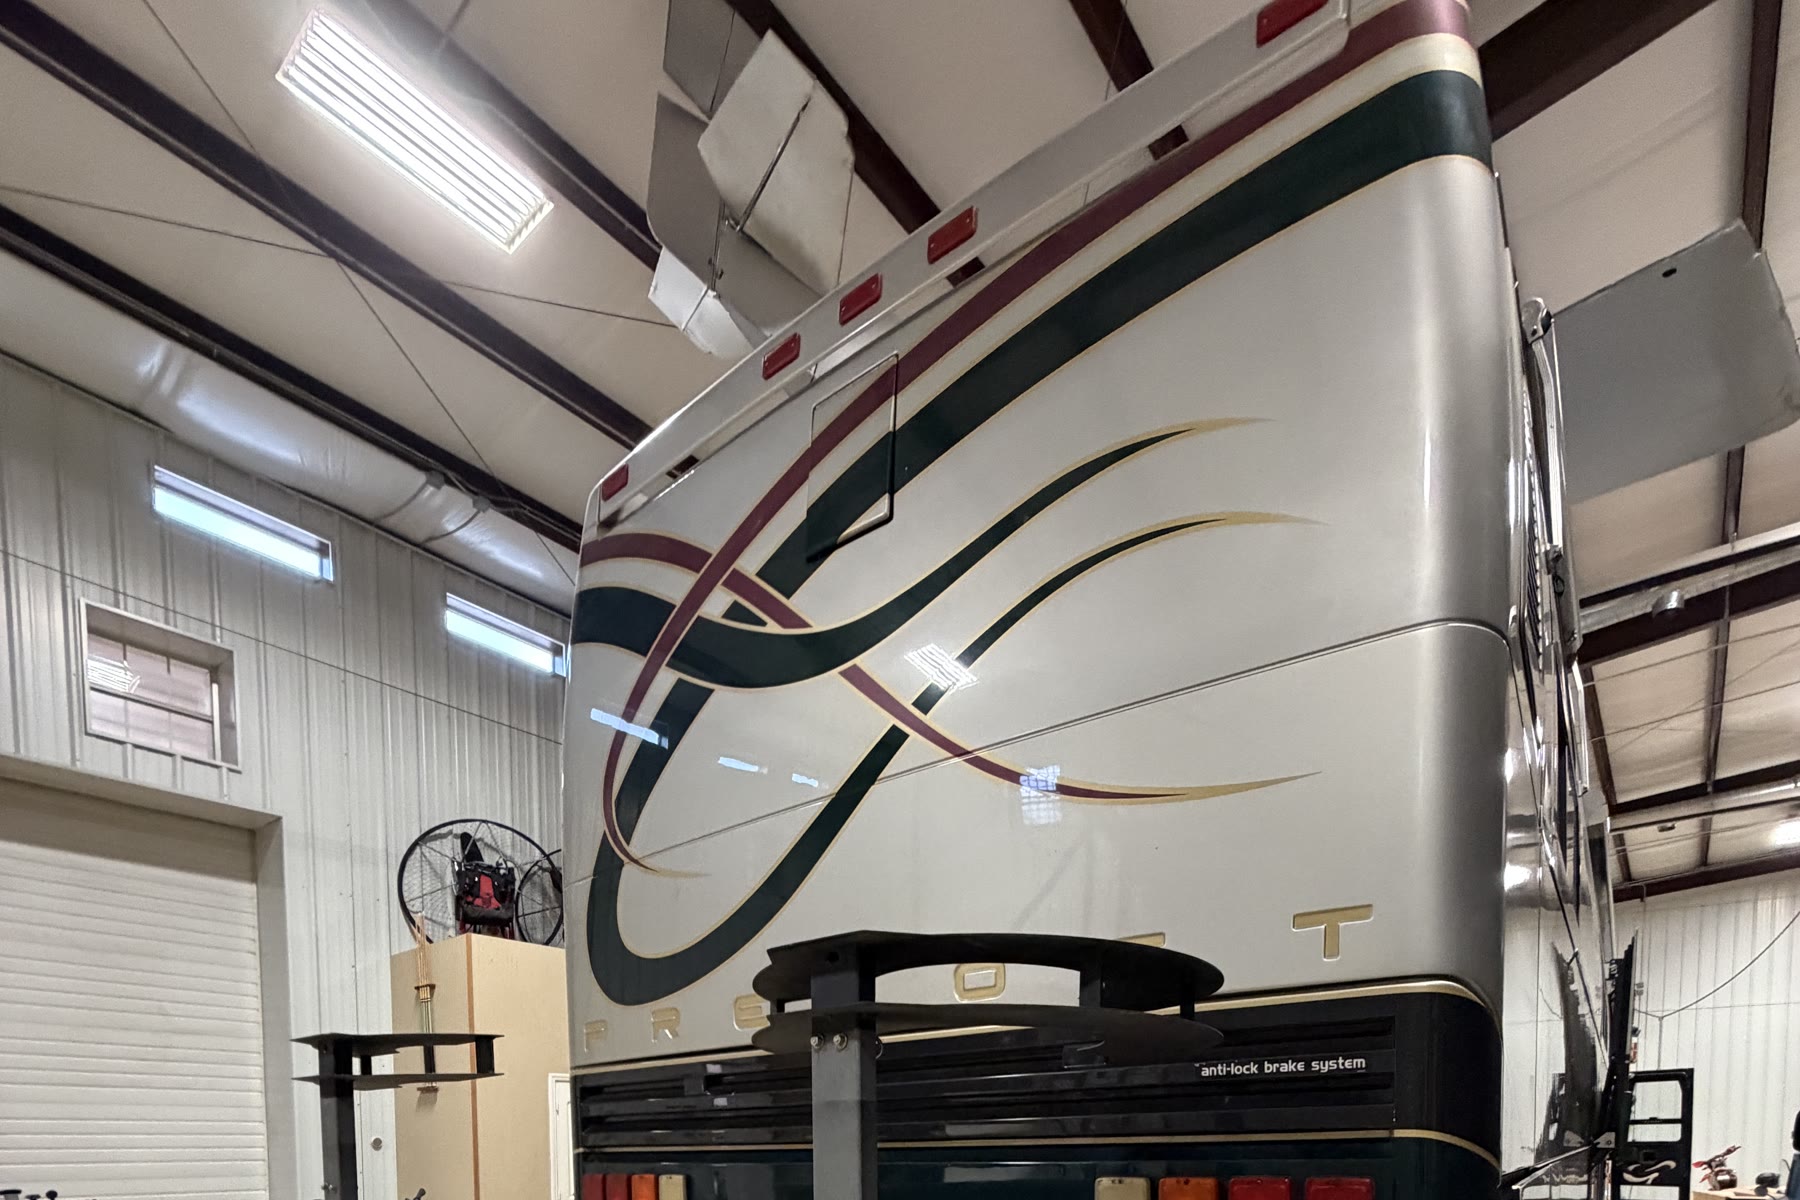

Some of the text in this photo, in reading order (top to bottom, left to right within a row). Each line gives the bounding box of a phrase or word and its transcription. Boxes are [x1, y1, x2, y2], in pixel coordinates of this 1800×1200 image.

[583, 904, 1375, 1052] PREOT
[1201, 1056, 1366, 1077] anti-lock brake system
